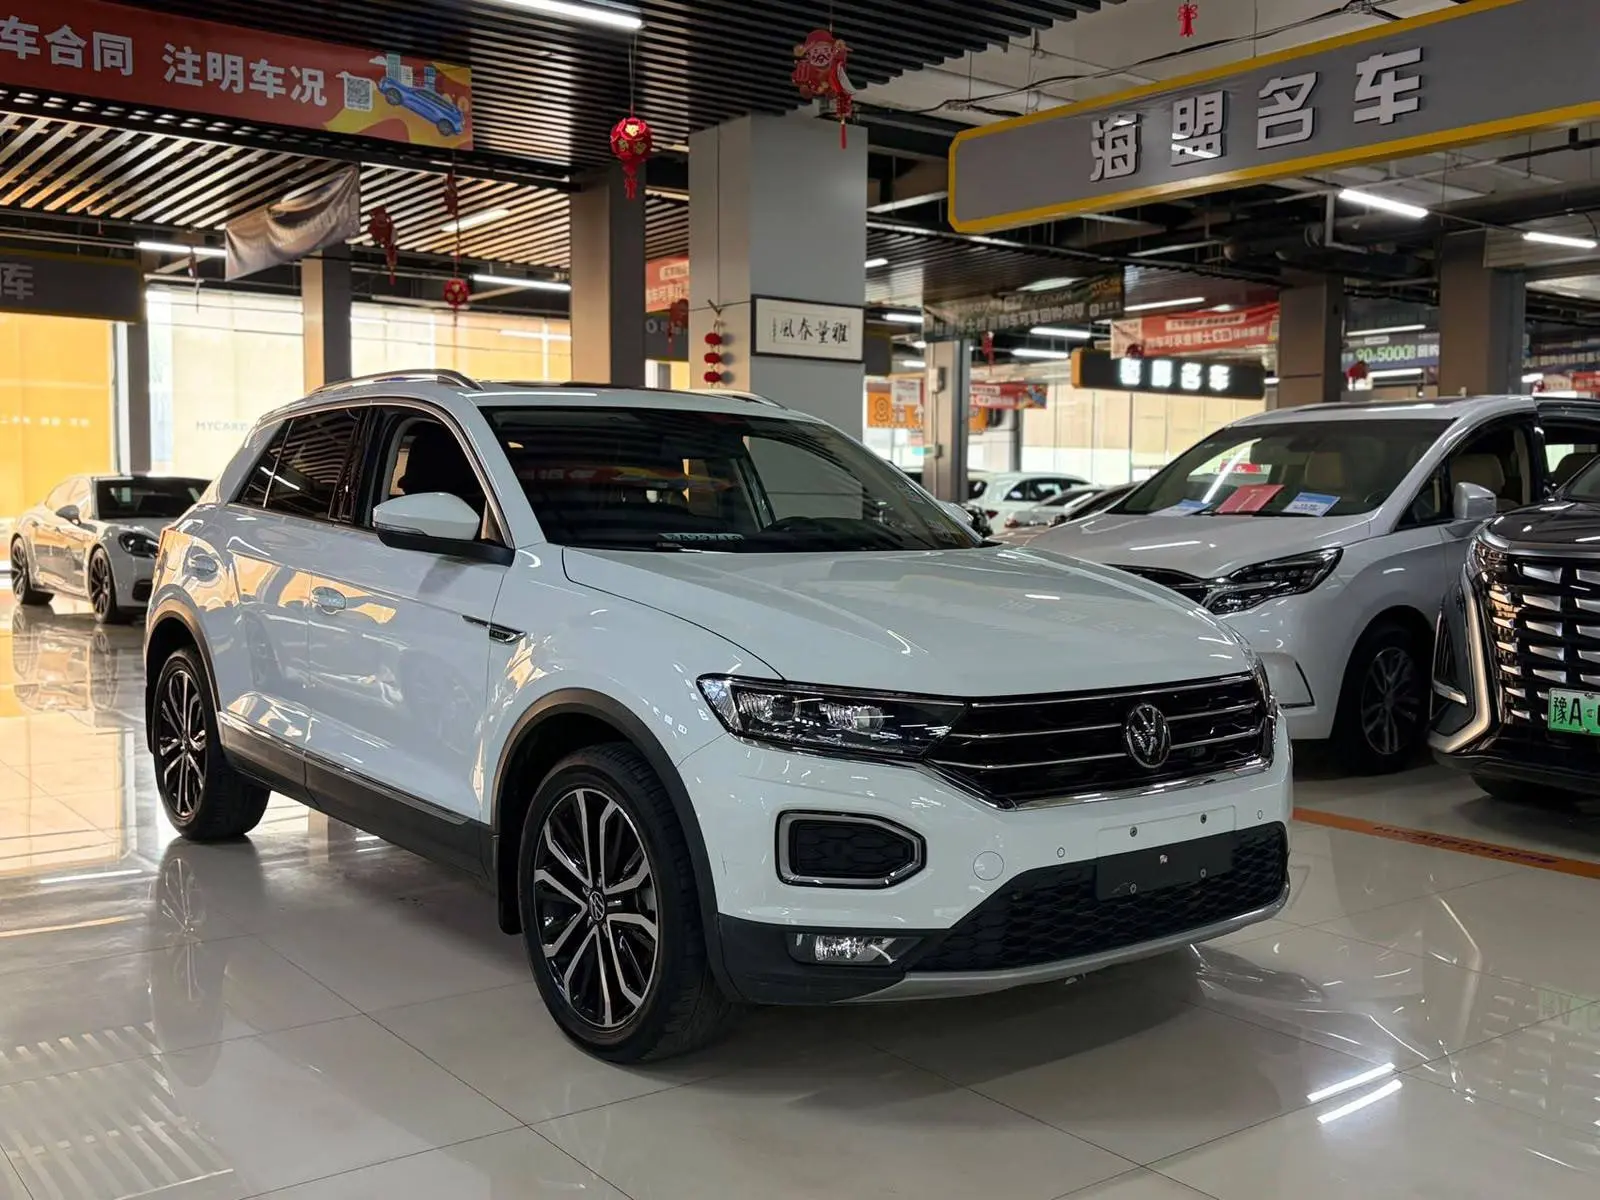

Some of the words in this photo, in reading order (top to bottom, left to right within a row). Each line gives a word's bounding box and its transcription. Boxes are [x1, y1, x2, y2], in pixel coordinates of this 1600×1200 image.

[0, 15, 134, 77] 车合同
[162, 43, 328, 107] 注明车况
[1089, 46, 1423, 182] 海盟名车
[1553, 696, 1600, 727] 豫A
